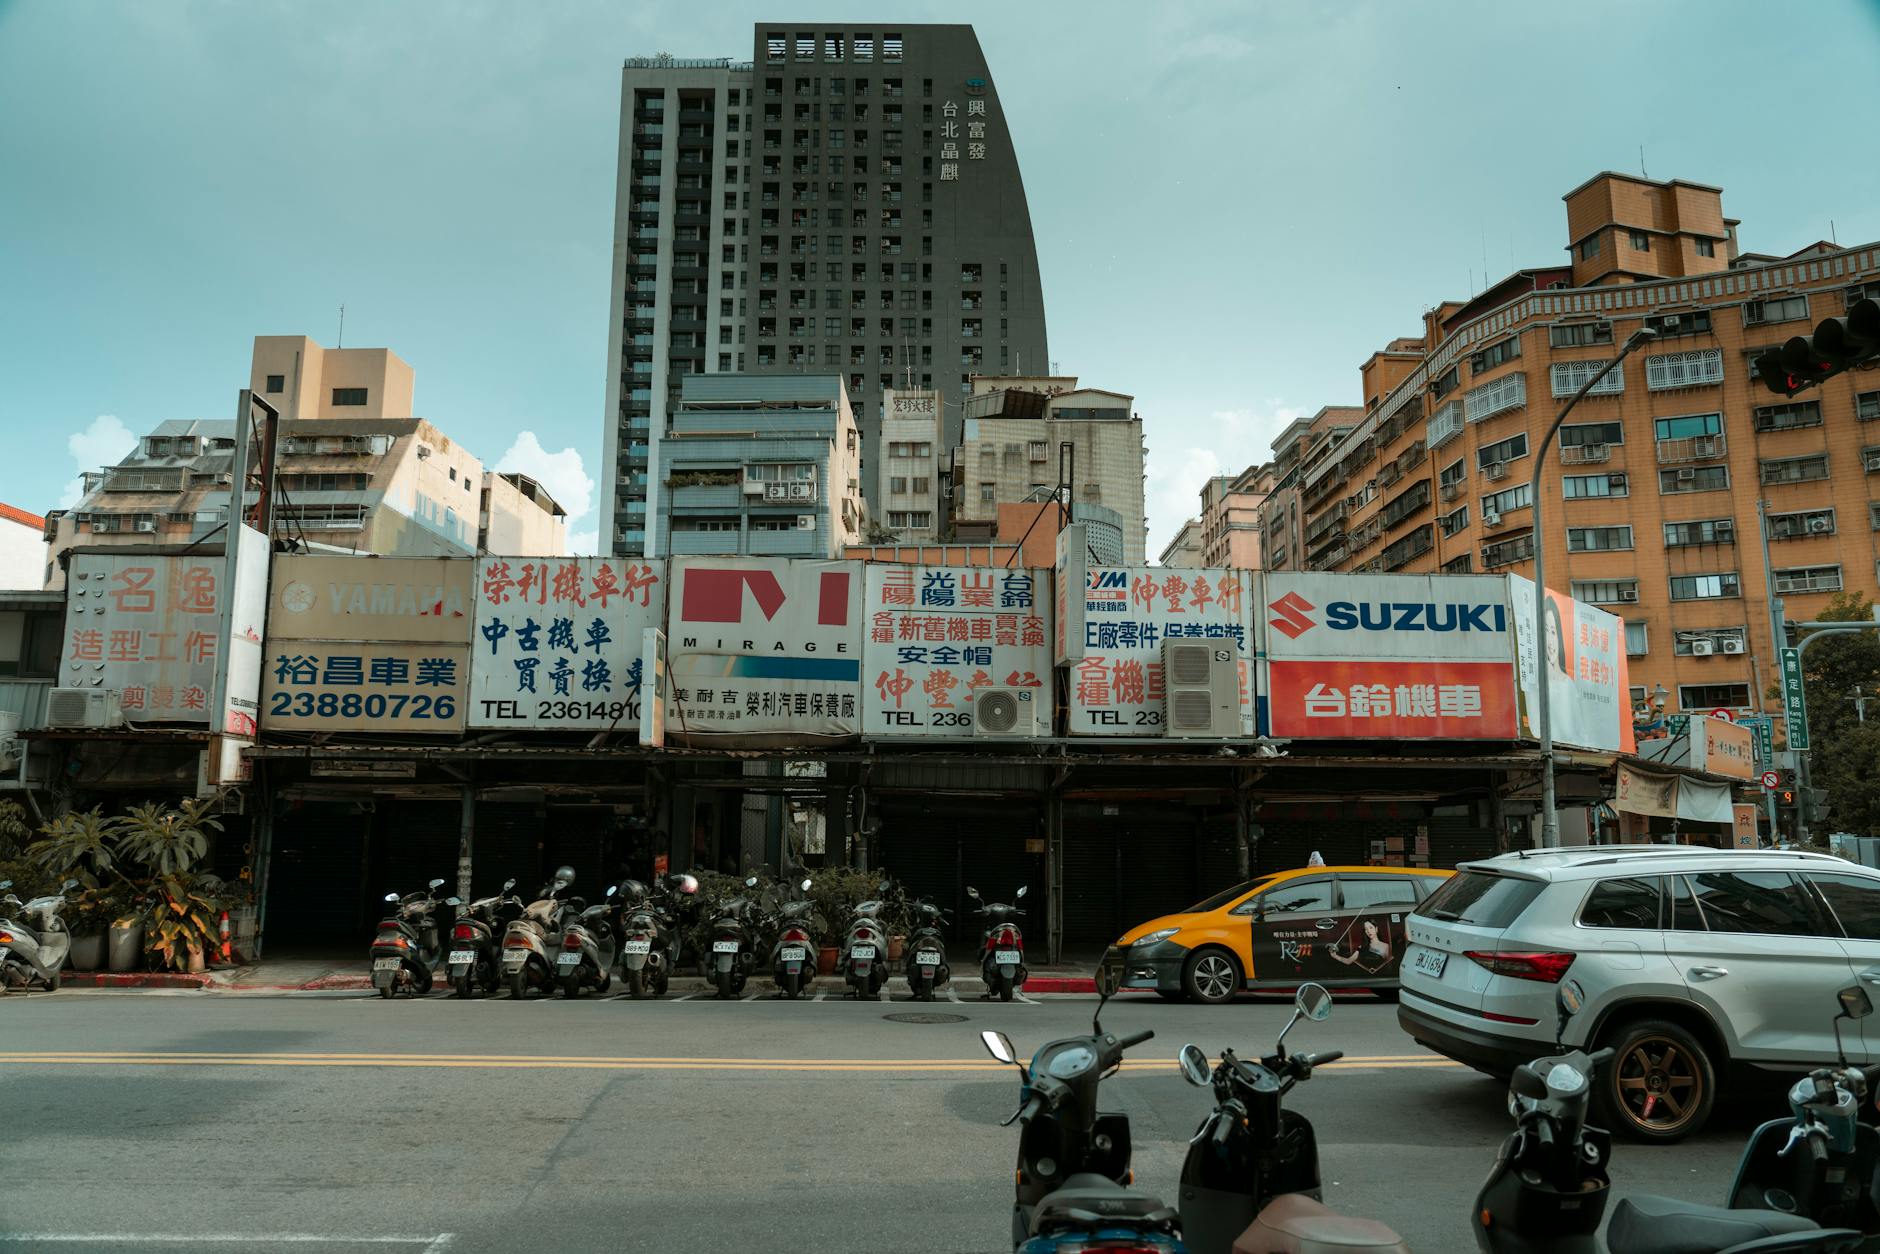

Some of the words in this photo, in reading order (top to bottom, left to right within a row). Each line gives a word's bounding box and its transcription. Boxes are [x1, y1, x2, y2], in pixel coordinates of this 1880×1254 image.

[940, 101, 959, 180] 台北晶麒
[967, 100, 986, 159] 興富發
[109, 566, 215, 613] 名逸
[328, 582, 464, 617] YAMAHA
[483, 562, 659, 608] 榮利機車行
[882, 571, 916, 605] 三陽
[921, 572, 955, 606] 光陽
[960, 573, 994, 608] 山葉
[1000, 574, 1034, 608] 台鈴
[1131, 574, 1245, 614] 仲豐車行
[872, 611, 896, 643] 各種
[899, 615, 993, 643] 新舊機車
[995, 614, 1018, 646] 買賣
[1021, 615, 1045, 646] 交換
[1325, 601, 1506, 632] SUZUKI
[481, 617, 612, 655] 中古機車
[683, 637, 848, 652] MIRAGE
[274, 655, 457, 687] 裕昌車業
[897, 646, 992, 665] 安全帽
[271, 692, 456, 720] 23880726
[481, 700, 527, 719] TEL
[1087, 710, 1128, 725] TEL
[1136, 711, 1162, 726] 23
[1304, 683, 1483, 718] 台鈴機車
[882, 711, 924, 726] TEL
